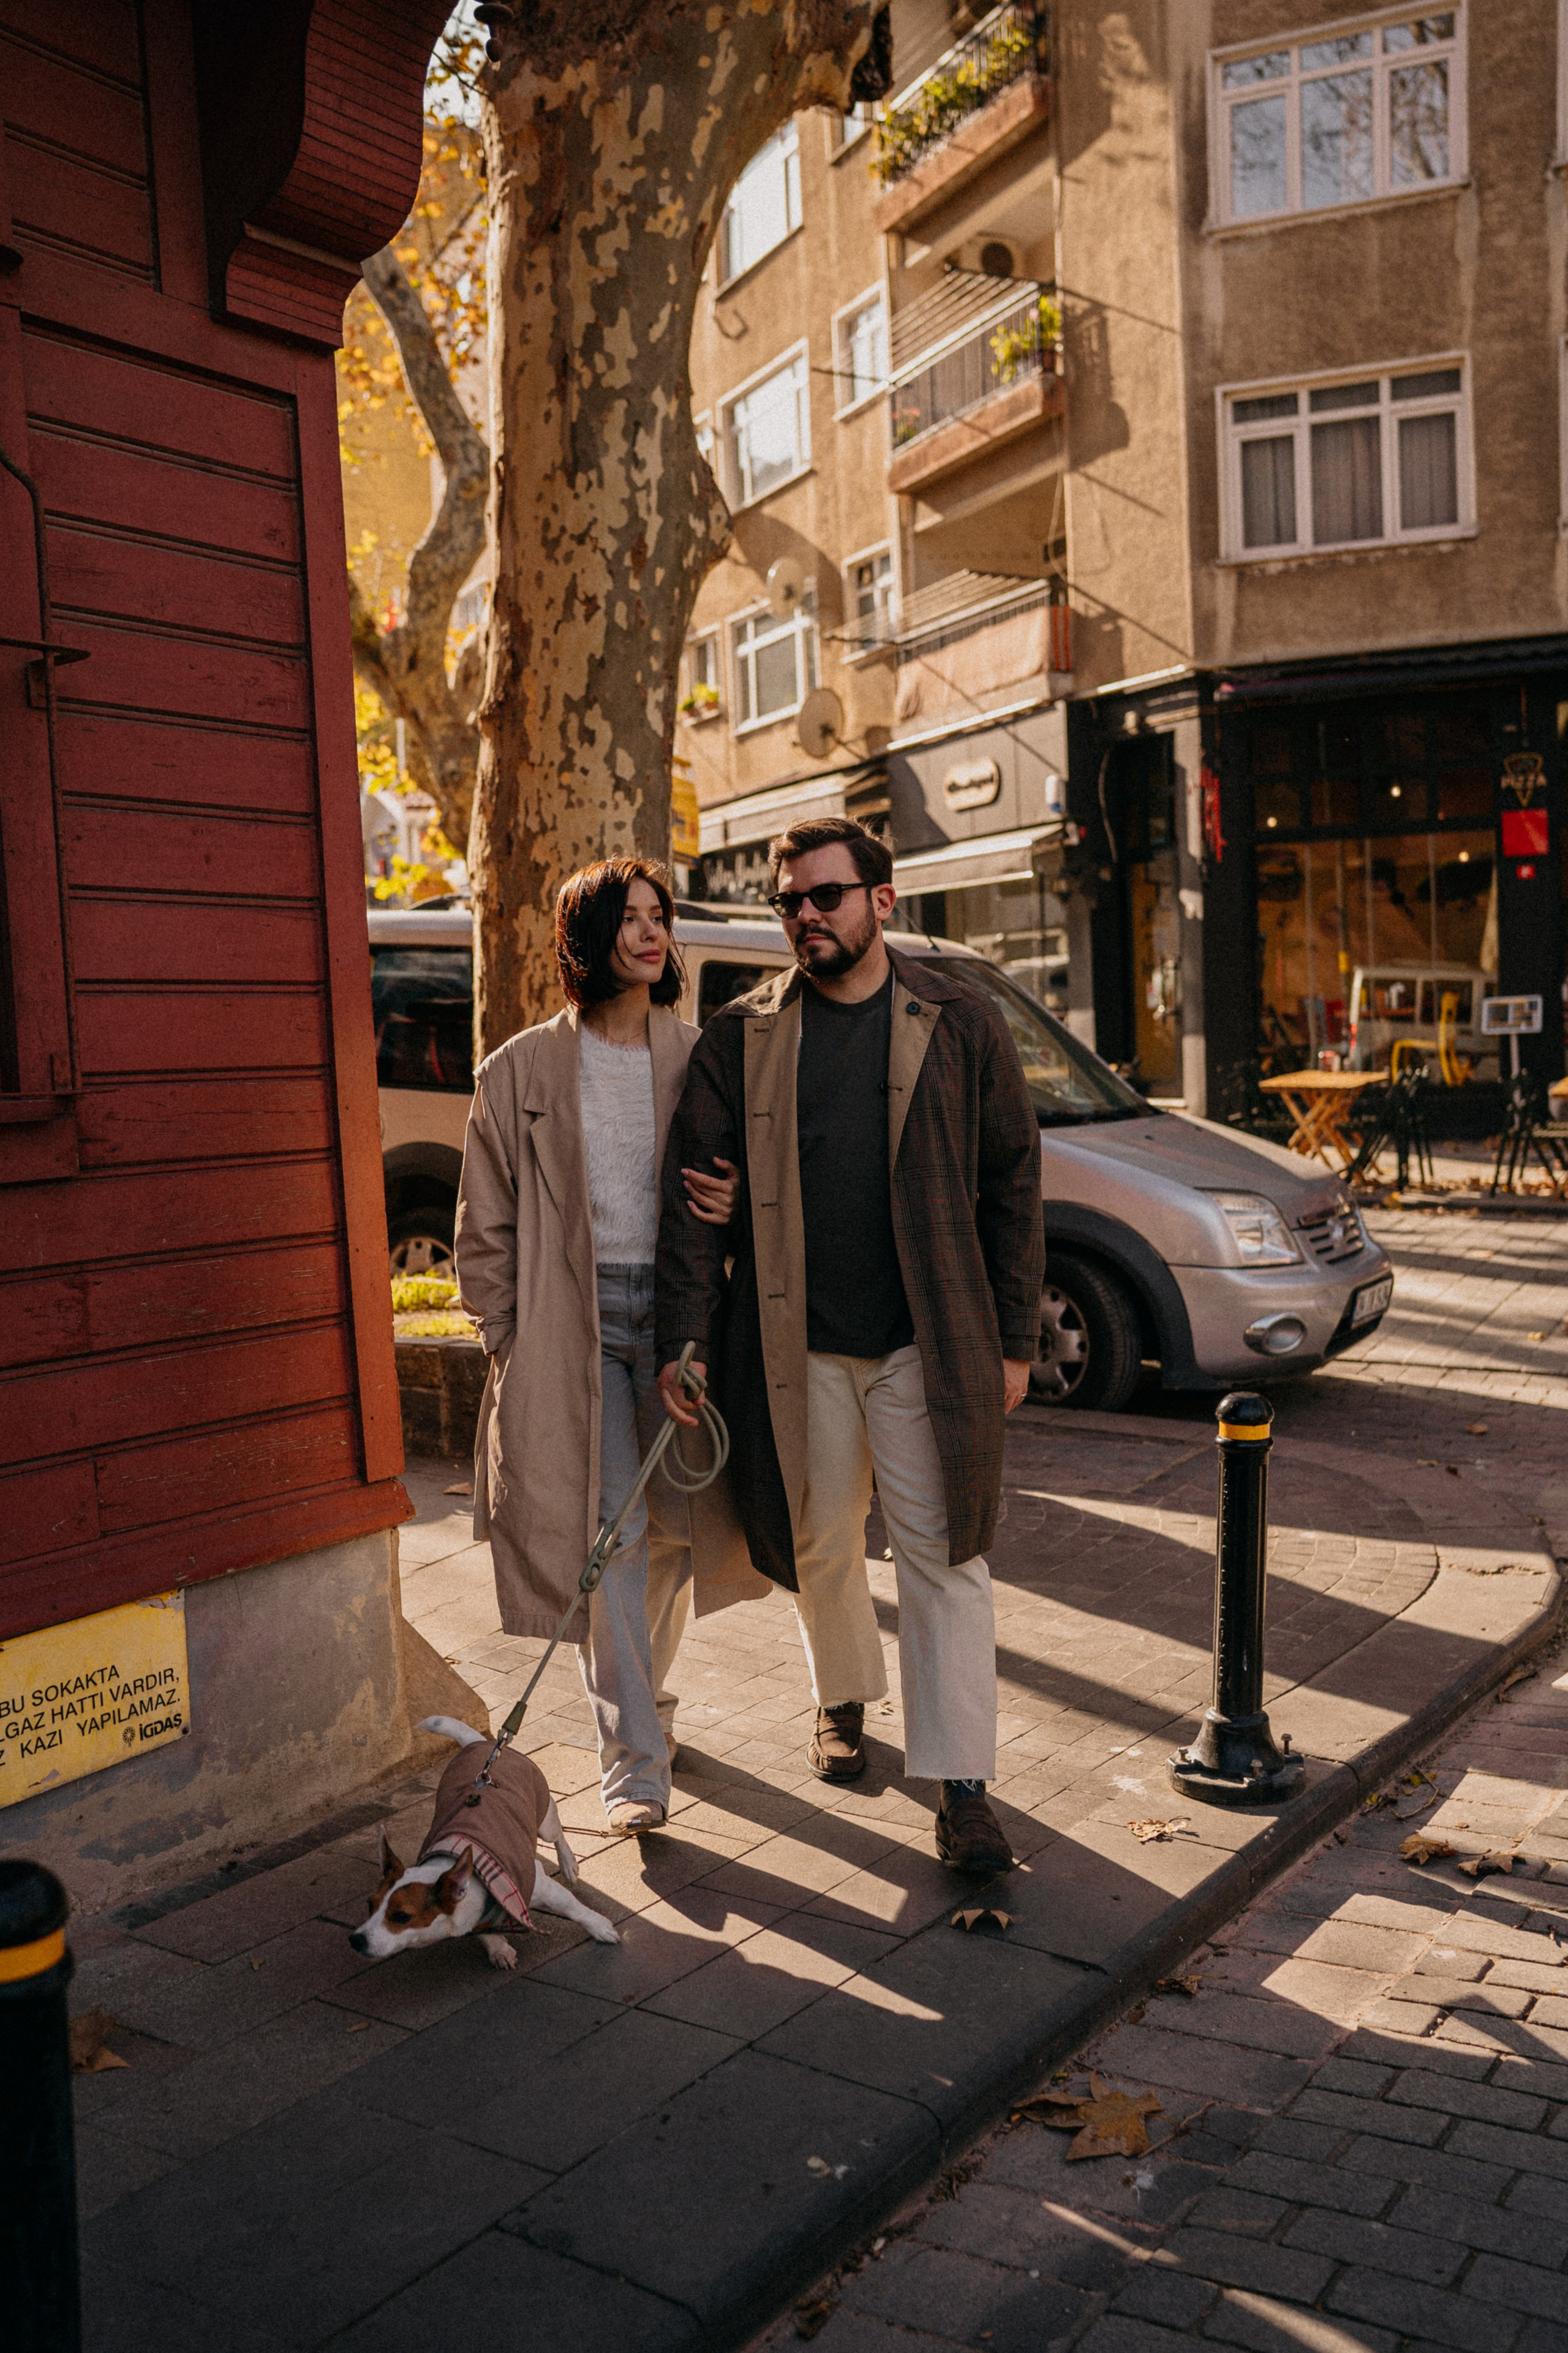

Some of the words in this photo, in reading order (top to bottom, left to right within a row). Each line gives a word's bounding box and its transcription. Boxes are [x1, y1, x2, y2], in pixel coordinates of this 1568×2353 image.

[0, 1695, 24, 1718] BU
[32, 1664, 120, 1707] SOKAKTA
[0, 1712, 46, 1742] GAZ
[51, 1691, 104, 1724] HATTI
[109, 1667, 179, 1702] VARDIR,
[20, 1729, 62, 1758] KAZI
[76, 1688, 181, 1737] YAPILAMAZ.
